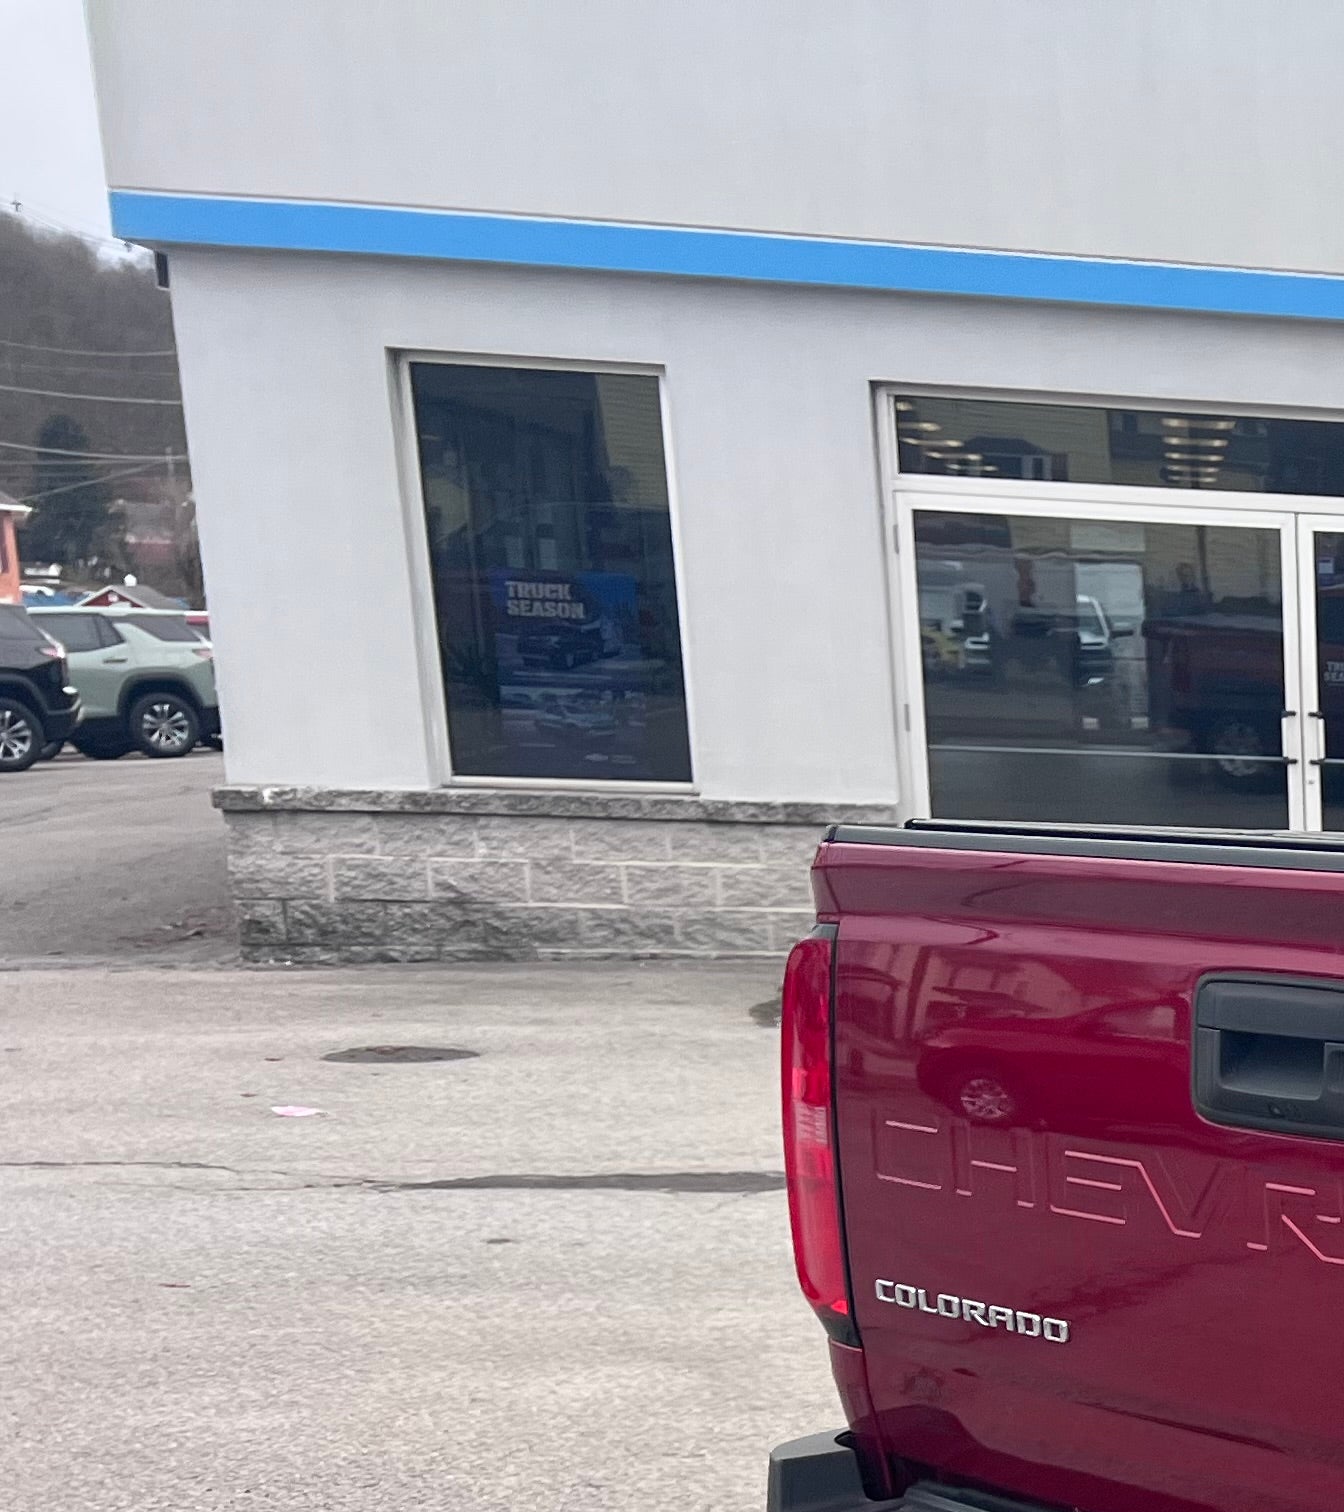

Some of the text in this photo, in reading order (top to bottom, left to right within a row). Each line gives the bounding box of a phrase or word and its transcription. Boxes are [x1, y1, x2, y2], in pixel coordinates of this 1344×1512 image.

[505, 581, 571, 600] TRUCK
[507, 601, 585, 620] SEASON
[875, 1278, 1070, 1343] COLORADO
